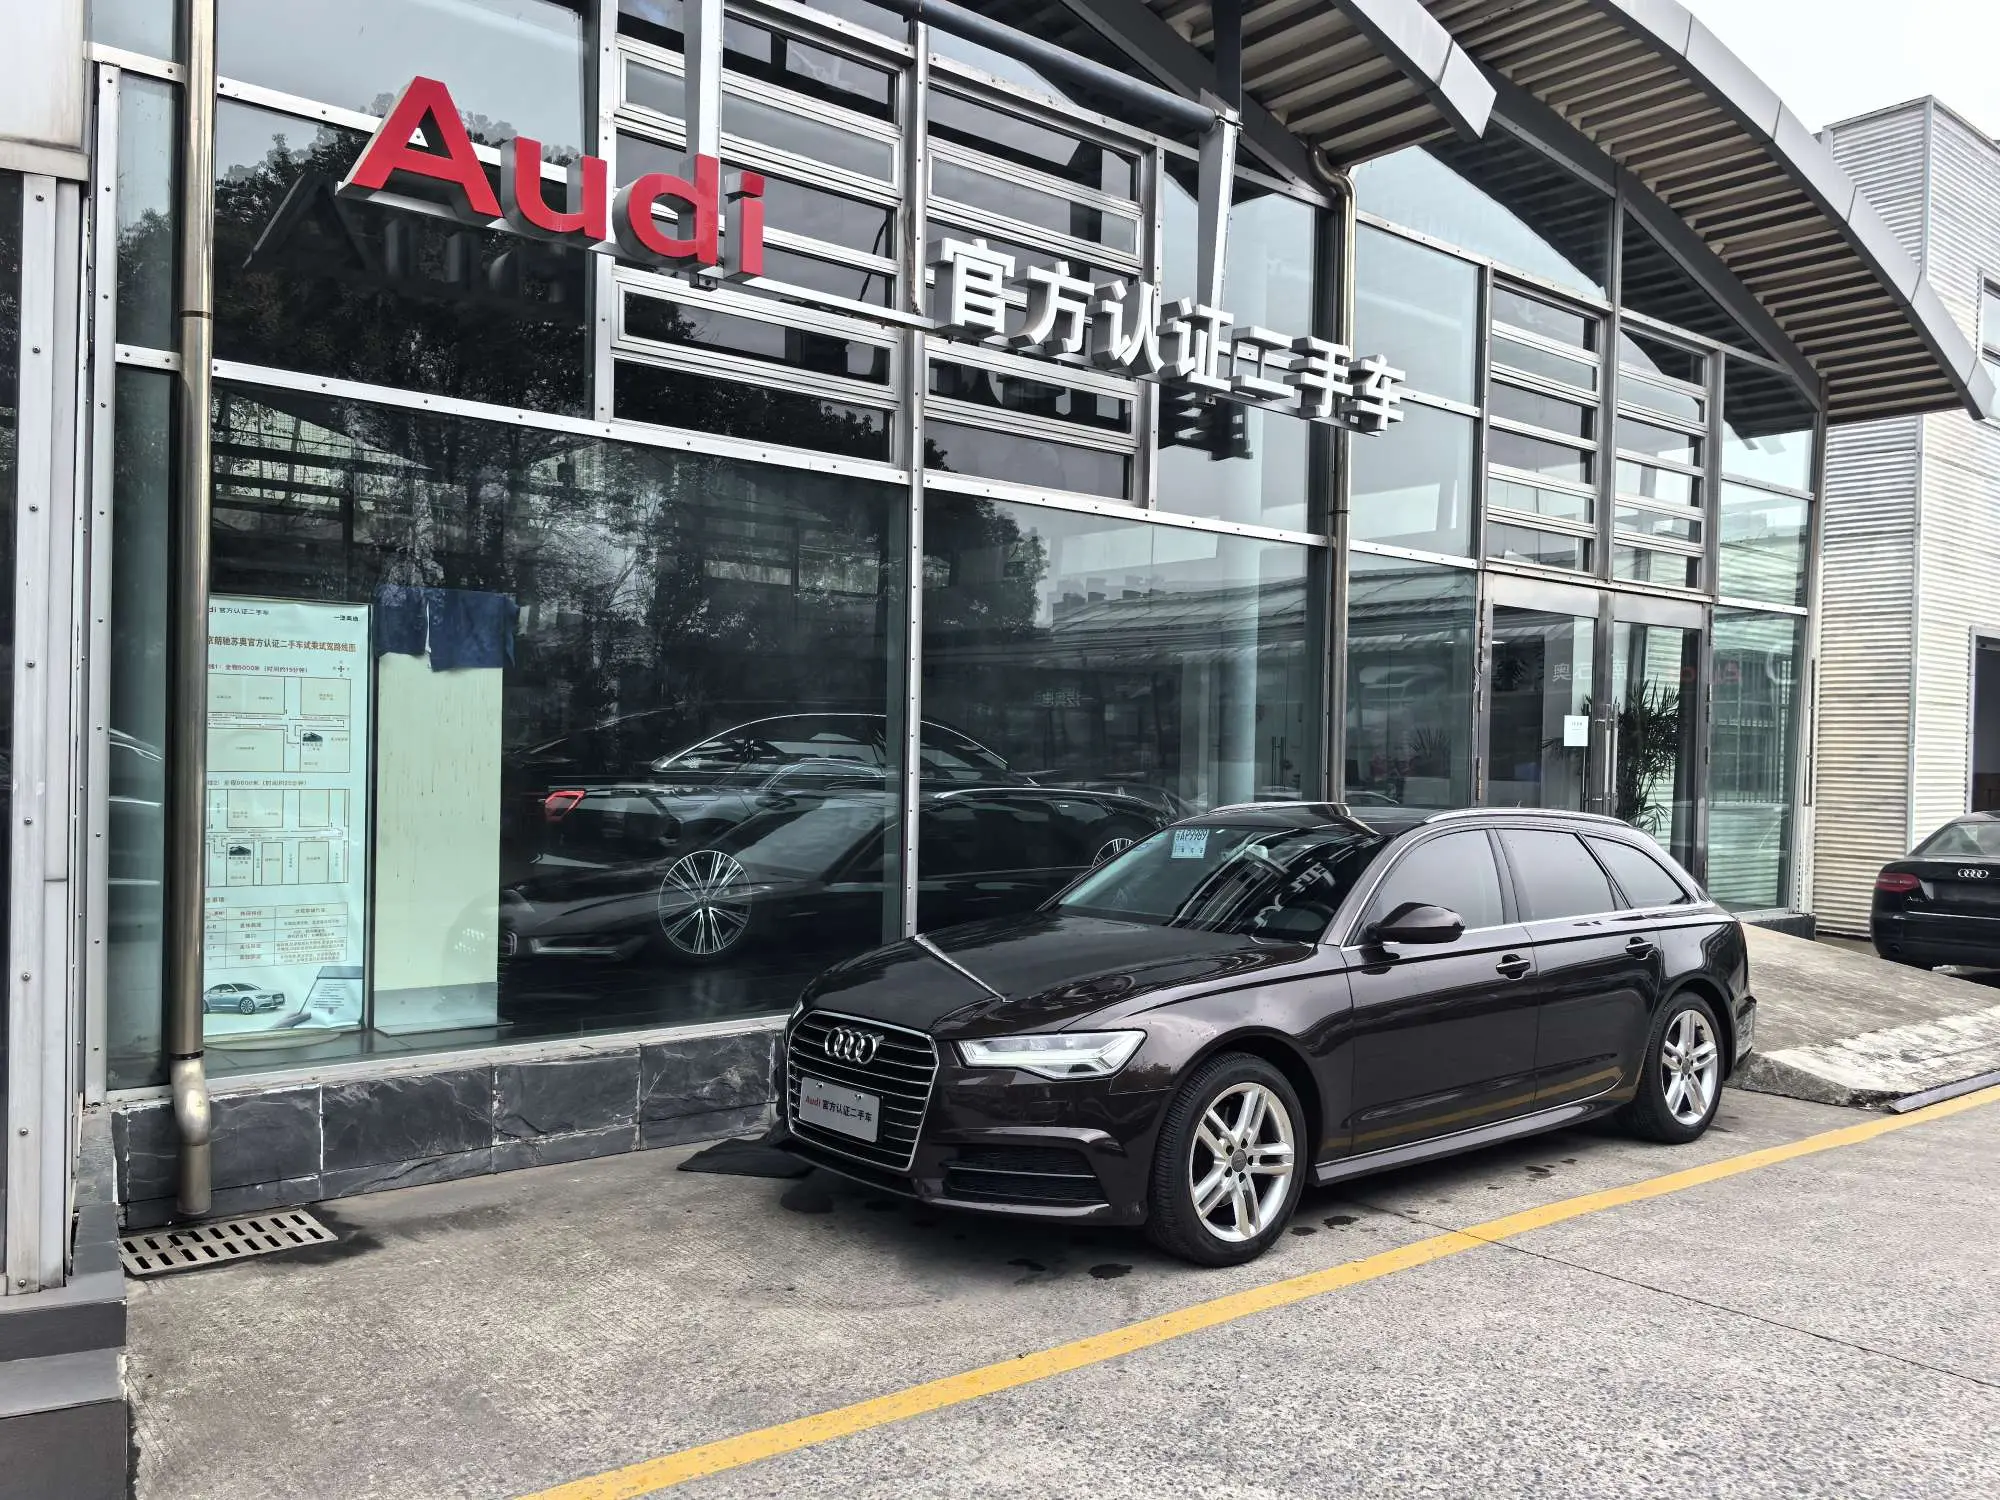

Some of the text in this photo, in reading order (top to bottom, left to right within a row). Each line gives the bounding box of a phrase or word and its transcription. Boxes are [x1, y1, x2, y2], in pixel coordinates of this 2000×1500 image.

[337, 76, 765, 278] Audi
[926, 238, 1406, 432] 官方认证二手车
[805, 1096, 872, 1123] Audi 官方认证二手车
